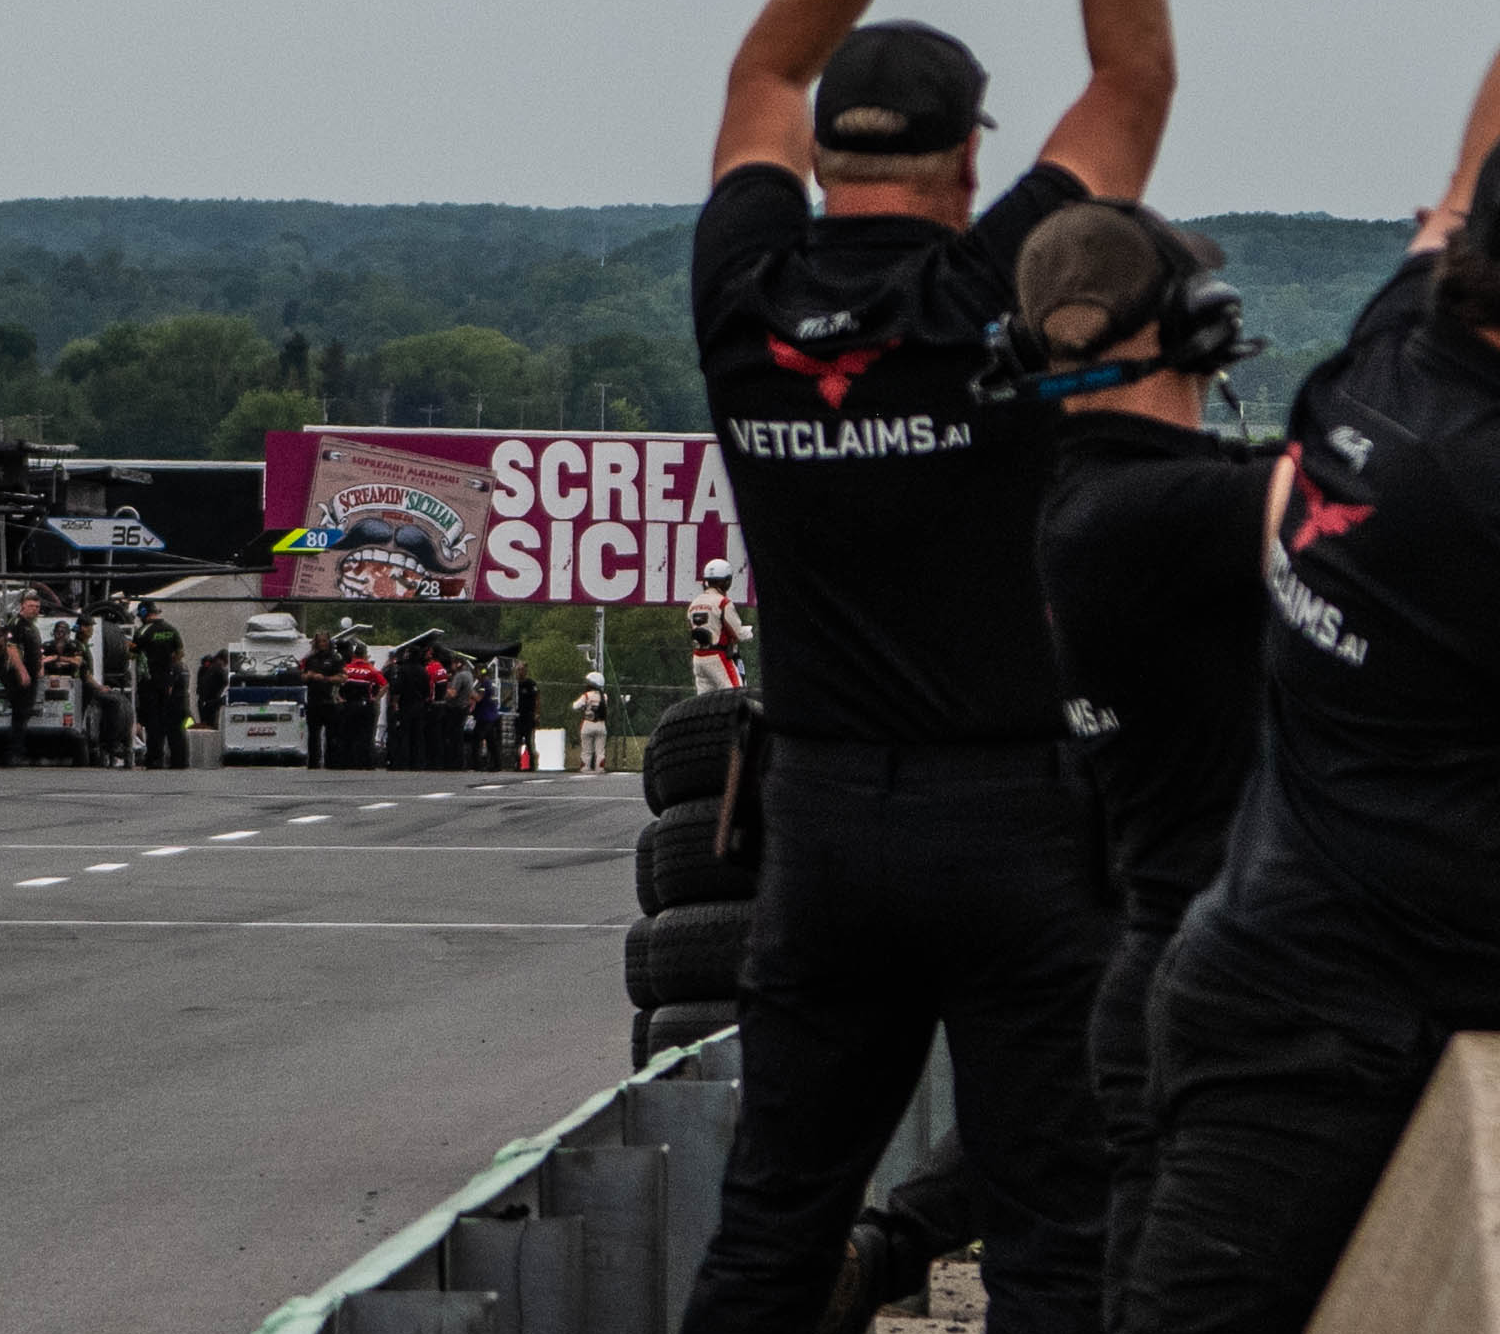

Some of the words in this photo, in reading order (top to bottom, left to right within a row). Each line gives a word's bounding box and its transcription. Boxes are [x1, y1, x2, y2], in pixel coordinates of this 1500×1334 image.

[111, 526, 141, 546] 36
[306, 531, 328, 547] 80
[420, 580, 440, 596] 28
